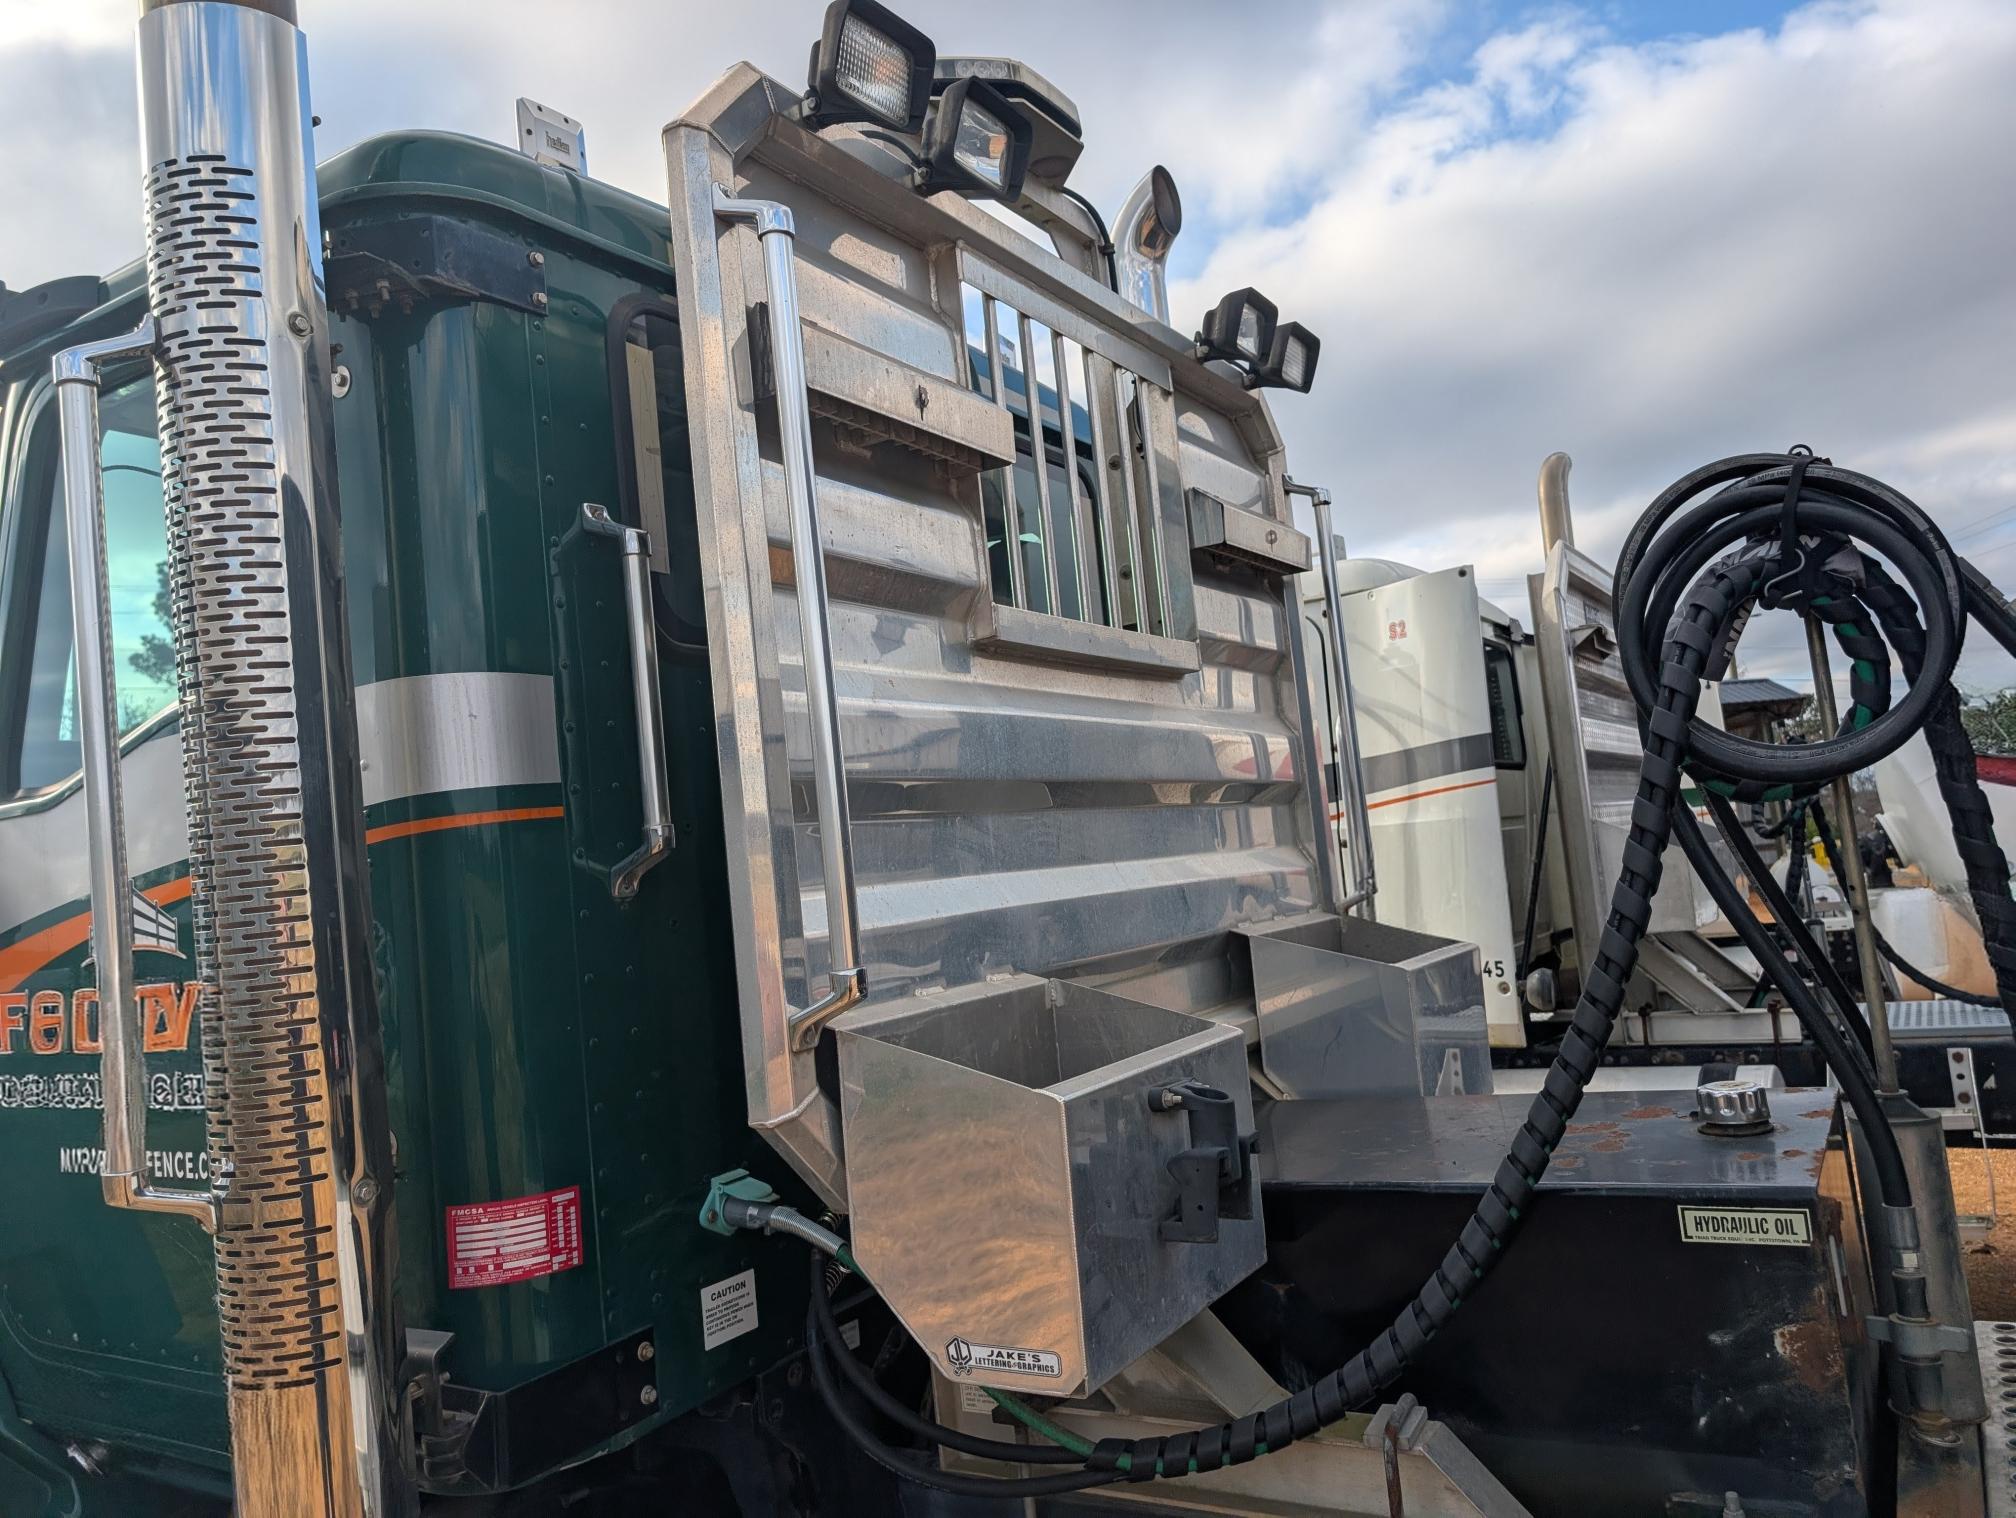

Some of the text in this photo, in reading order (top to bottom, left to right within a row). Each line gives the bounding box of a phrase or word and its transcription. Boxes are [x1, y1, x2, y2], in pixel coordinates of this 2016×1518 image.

[1482, 960, 1505, 978] 45
[451, 1207, 484, 1216] FMCSA
[1693, 1215, 1799, 1236] HYDRAULIC OIL
[710, 1280, 747, 1302] CAUTION
[986, 1349, 1042, 1363] JAKE'S
[975, 1357, 1012, 1369] LETTERING
[1017, 1361, 1055, 1374] GRAPHICS
